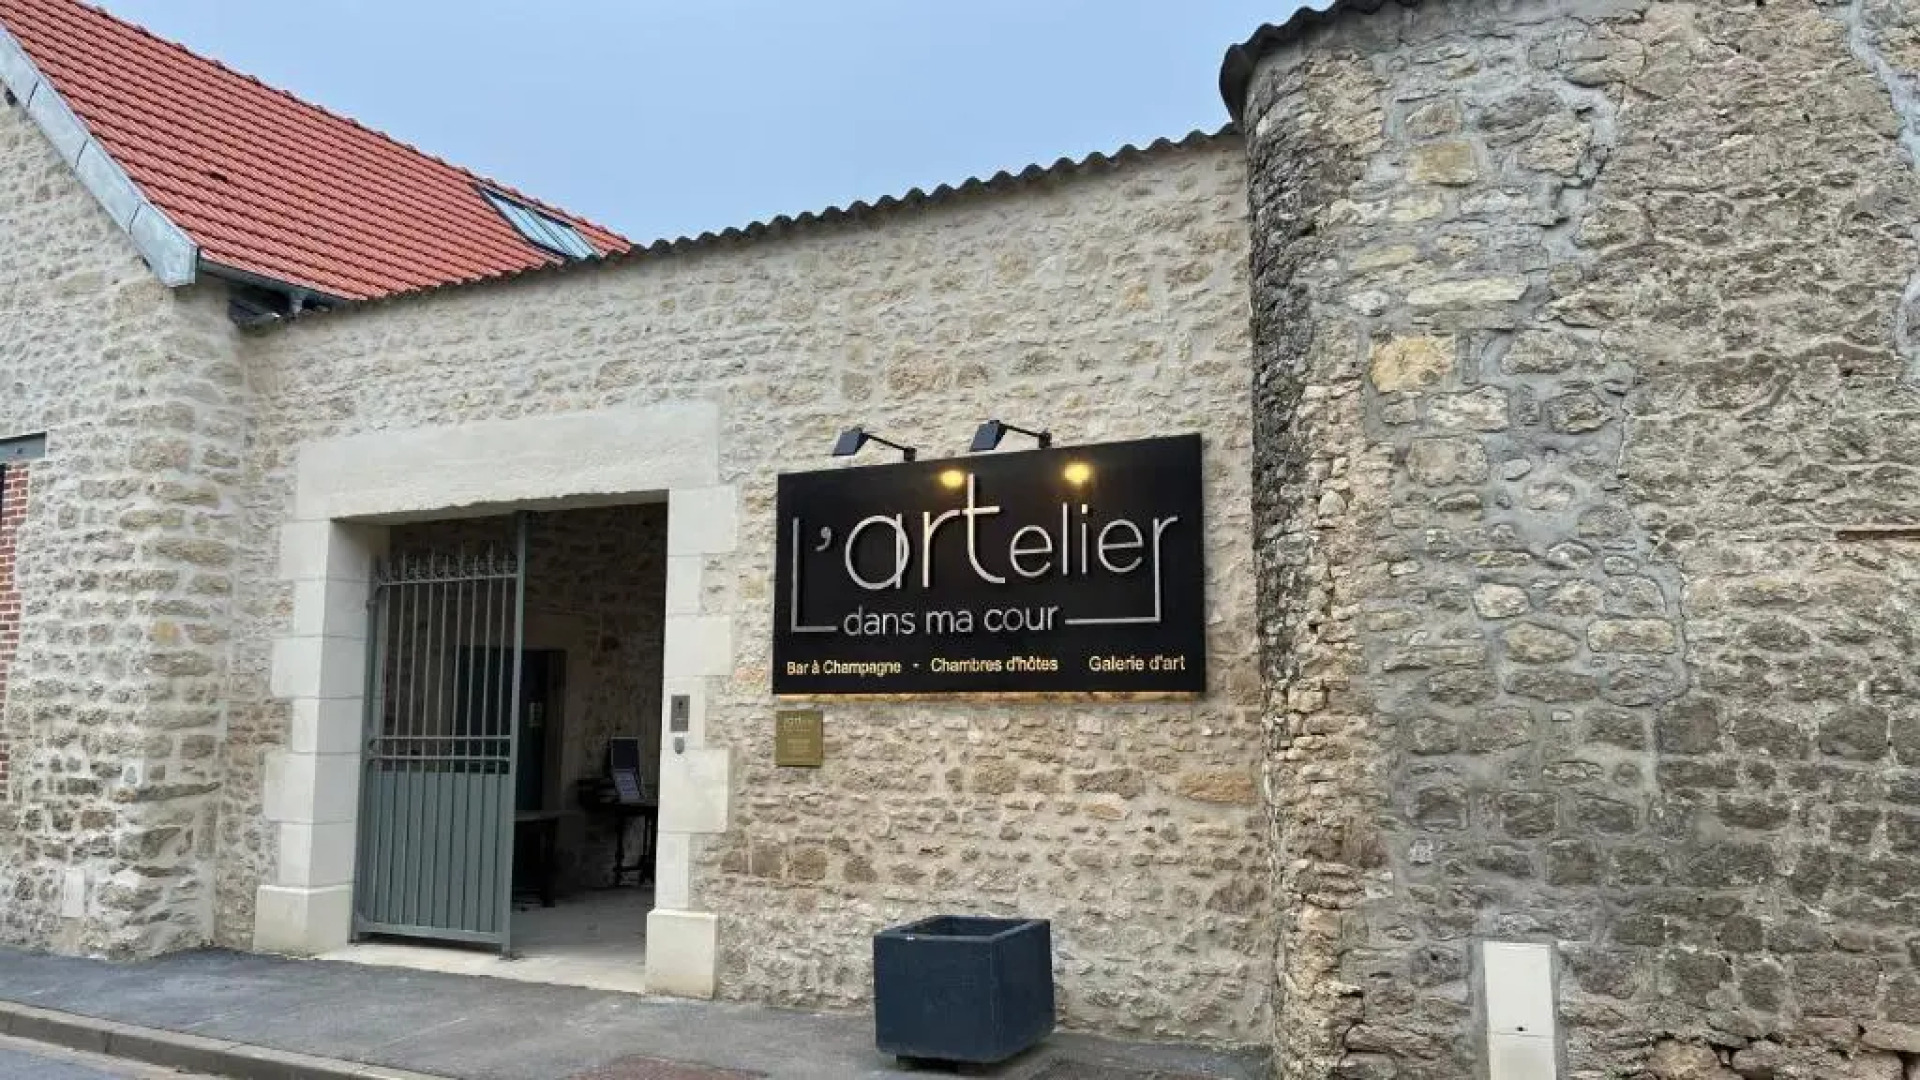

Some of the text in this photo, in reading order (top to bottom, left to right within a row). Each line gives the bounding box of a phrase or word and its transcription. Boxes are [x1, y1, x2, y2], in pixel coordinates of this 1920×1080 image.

[843, 604, 1058, 636] dans ma cour
[787, 661, 808, 675] Bar
[811, 660, 819, 674] à
[823, 660, 901, 677] Champagne
[931, 657, 1001, 672] Chambres
[1006, 656, 1058, 671] d'hôtes
[1089, 654, 1144, 671] Galerie
[1149, 654, 1185, 670] d'art
